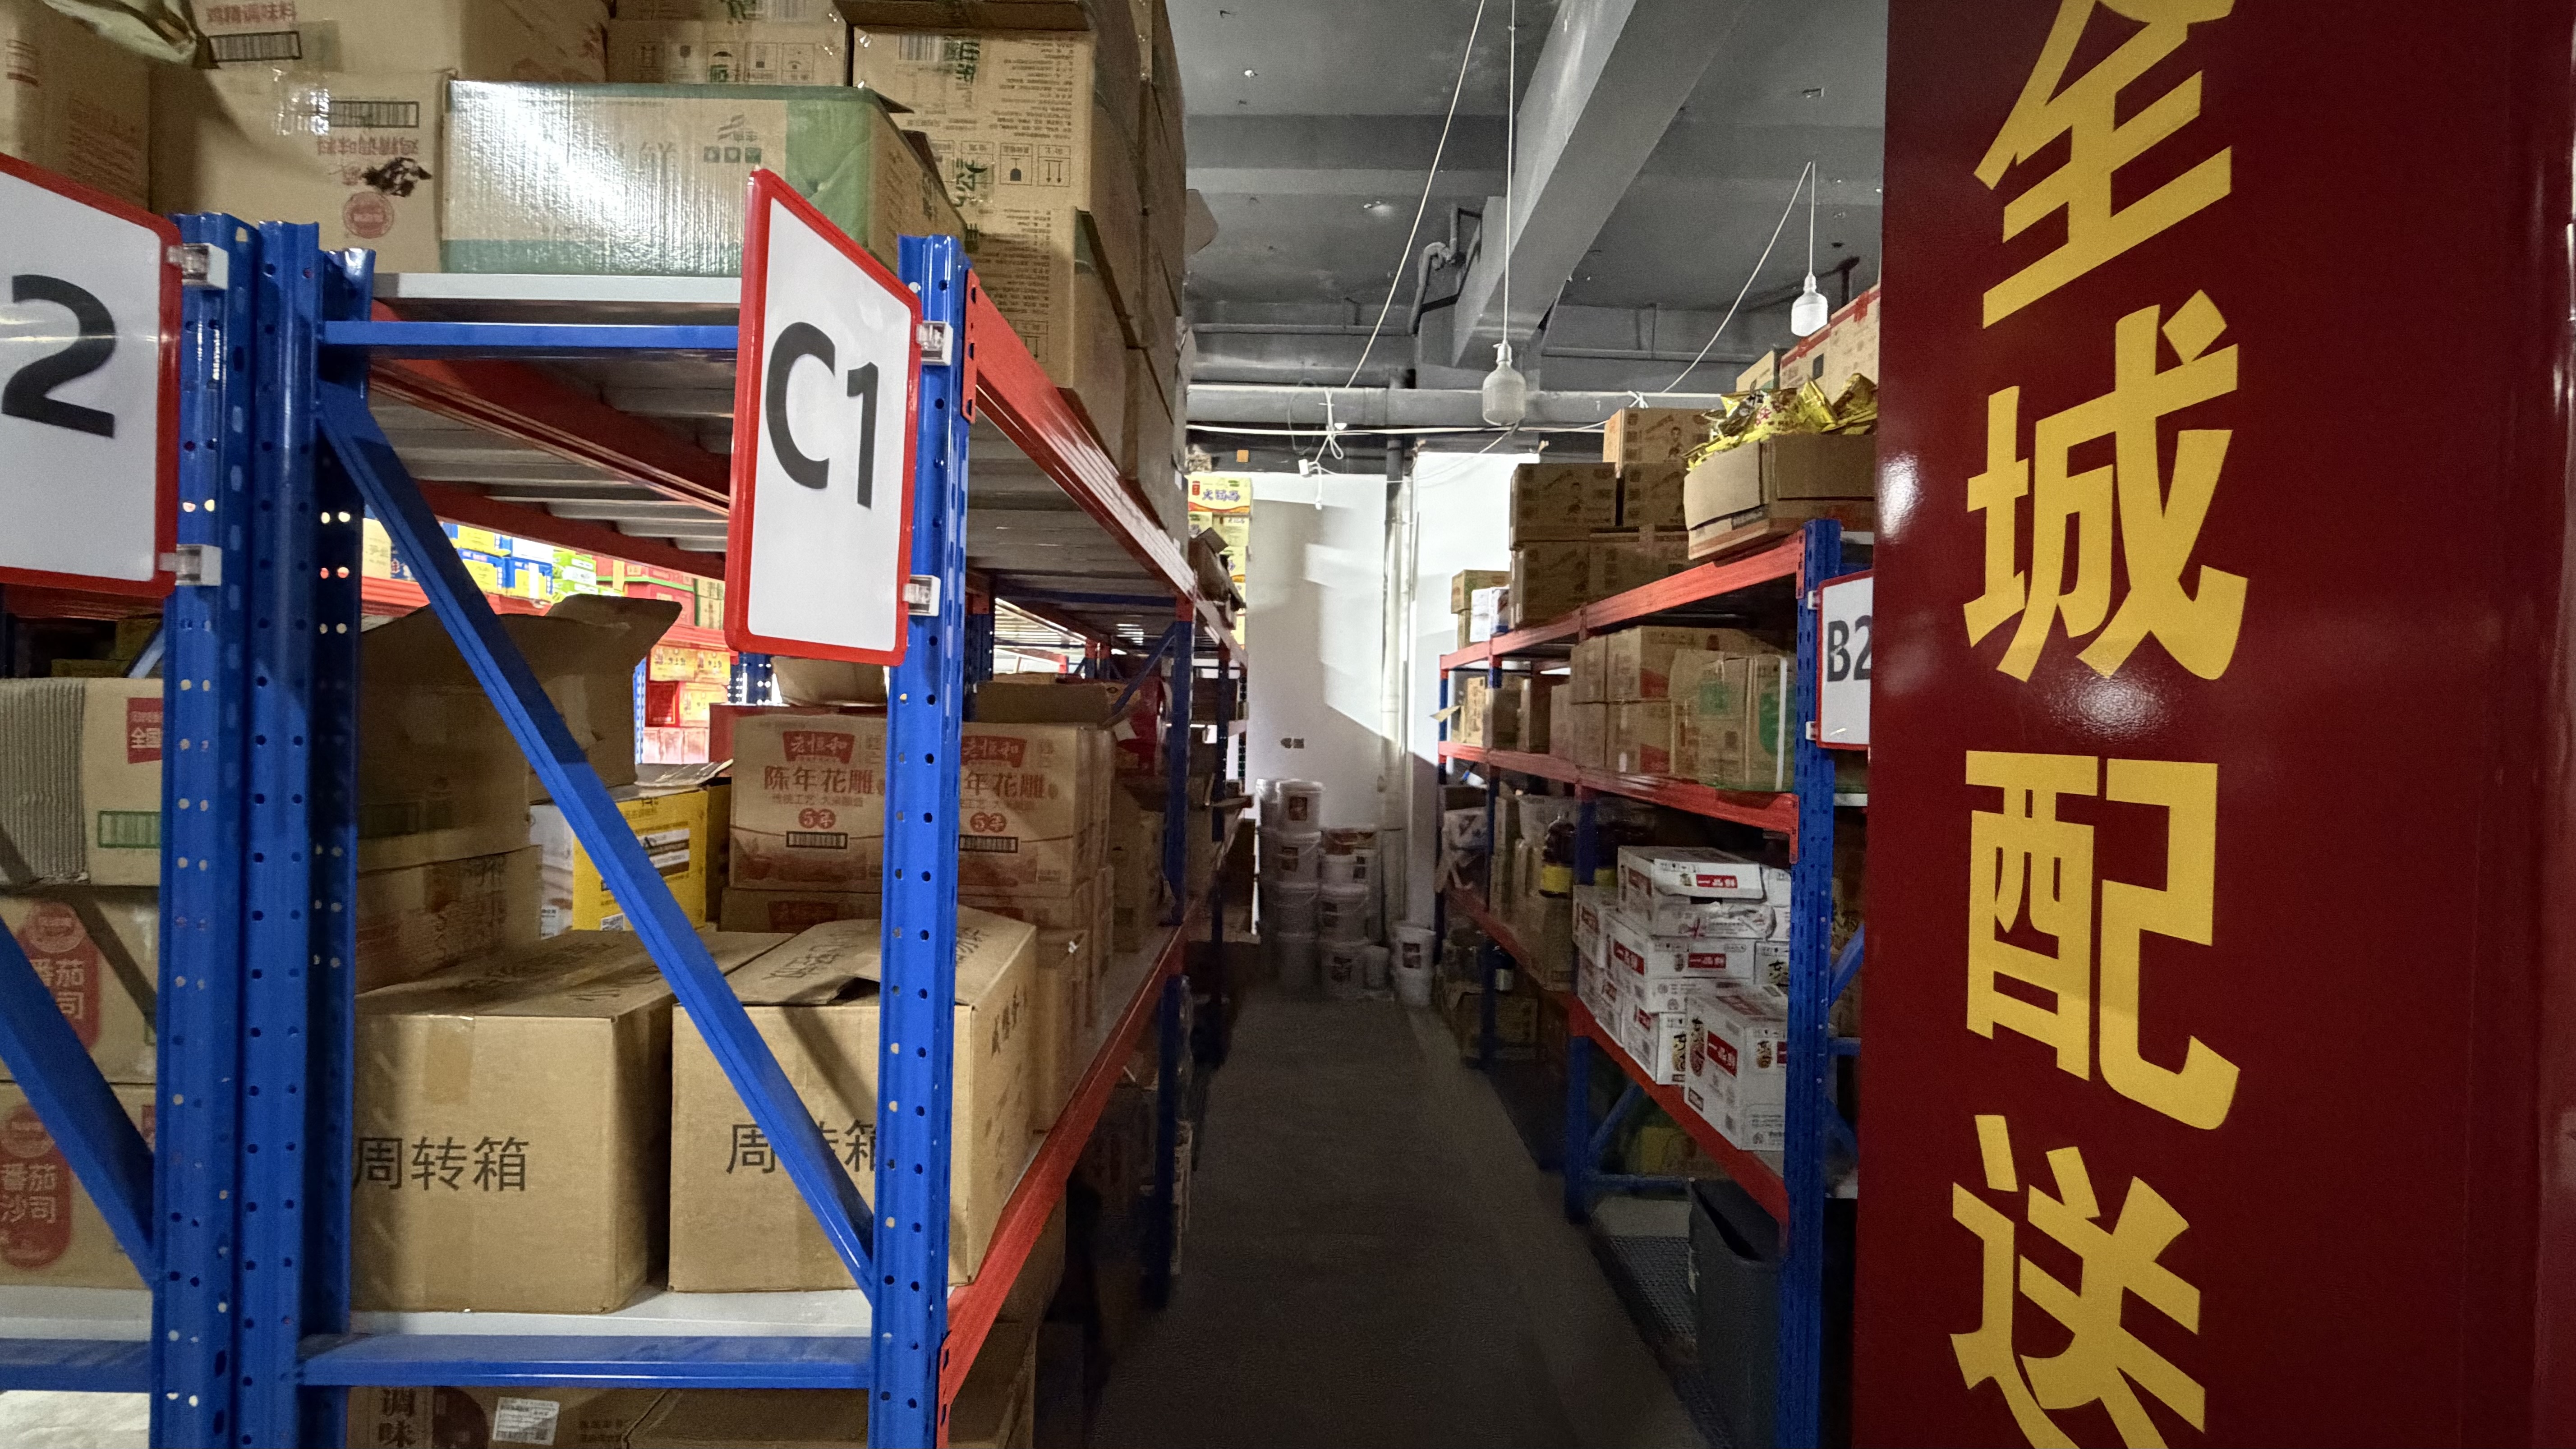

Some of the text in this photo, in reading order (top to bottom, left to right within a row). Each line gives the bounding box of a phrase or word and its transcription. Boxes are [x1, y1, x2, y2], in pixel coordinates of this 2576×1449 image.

[1, 274, 116, 439] 2
[765, 322, 879, 511] C1
[1827, 615, 1872, 682] B2
[791, 732, 848, 752] 老恒和
[1950, 0, 2248, 1449] 全城配送
[764, 766, 874, 795] 陈年花雕
[1, 1163, 58, 1191] 番茄
[352, 1136, 530, 1191] 周转箱
